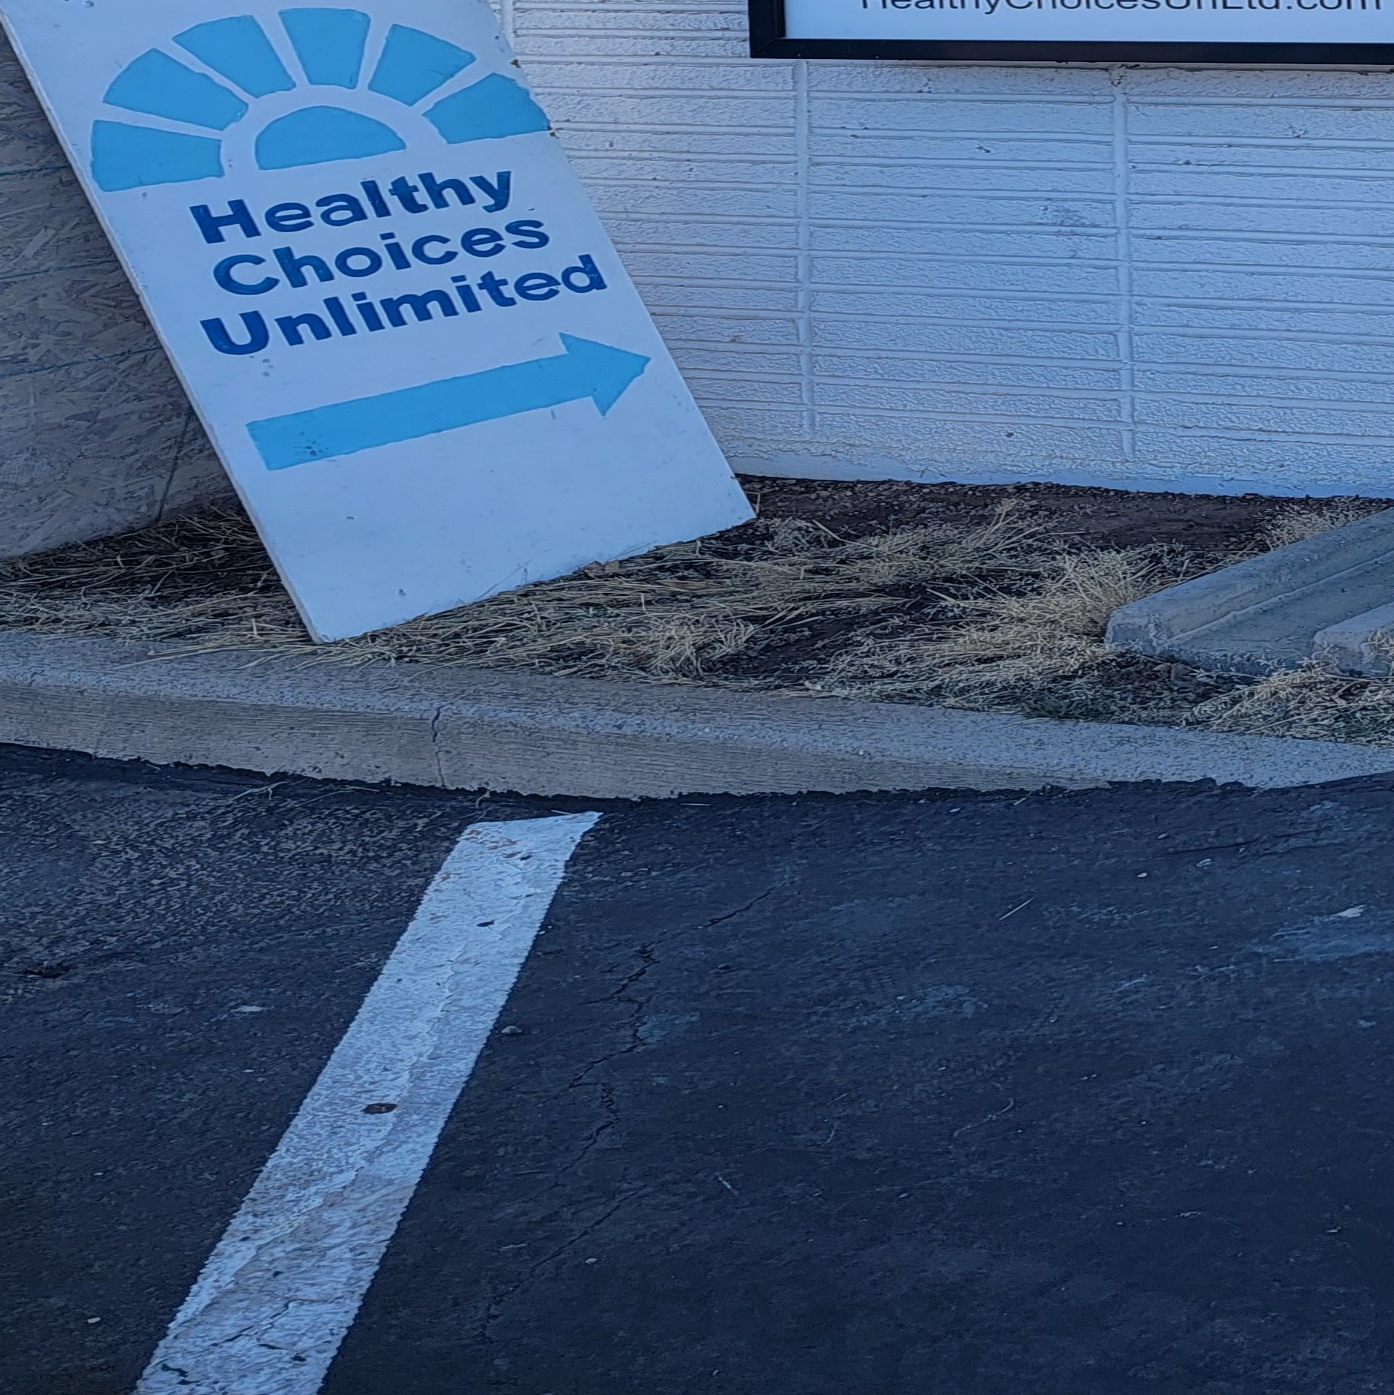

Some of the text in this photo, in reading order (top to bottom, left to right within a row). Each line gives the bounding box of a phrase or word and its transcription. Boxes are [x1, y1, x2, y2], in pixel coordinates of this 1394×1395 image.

[190, 169, 513, 245] Healthy
[213, 219, 550, 297] Choices
[200, 253, 608, 357] Unlimited
